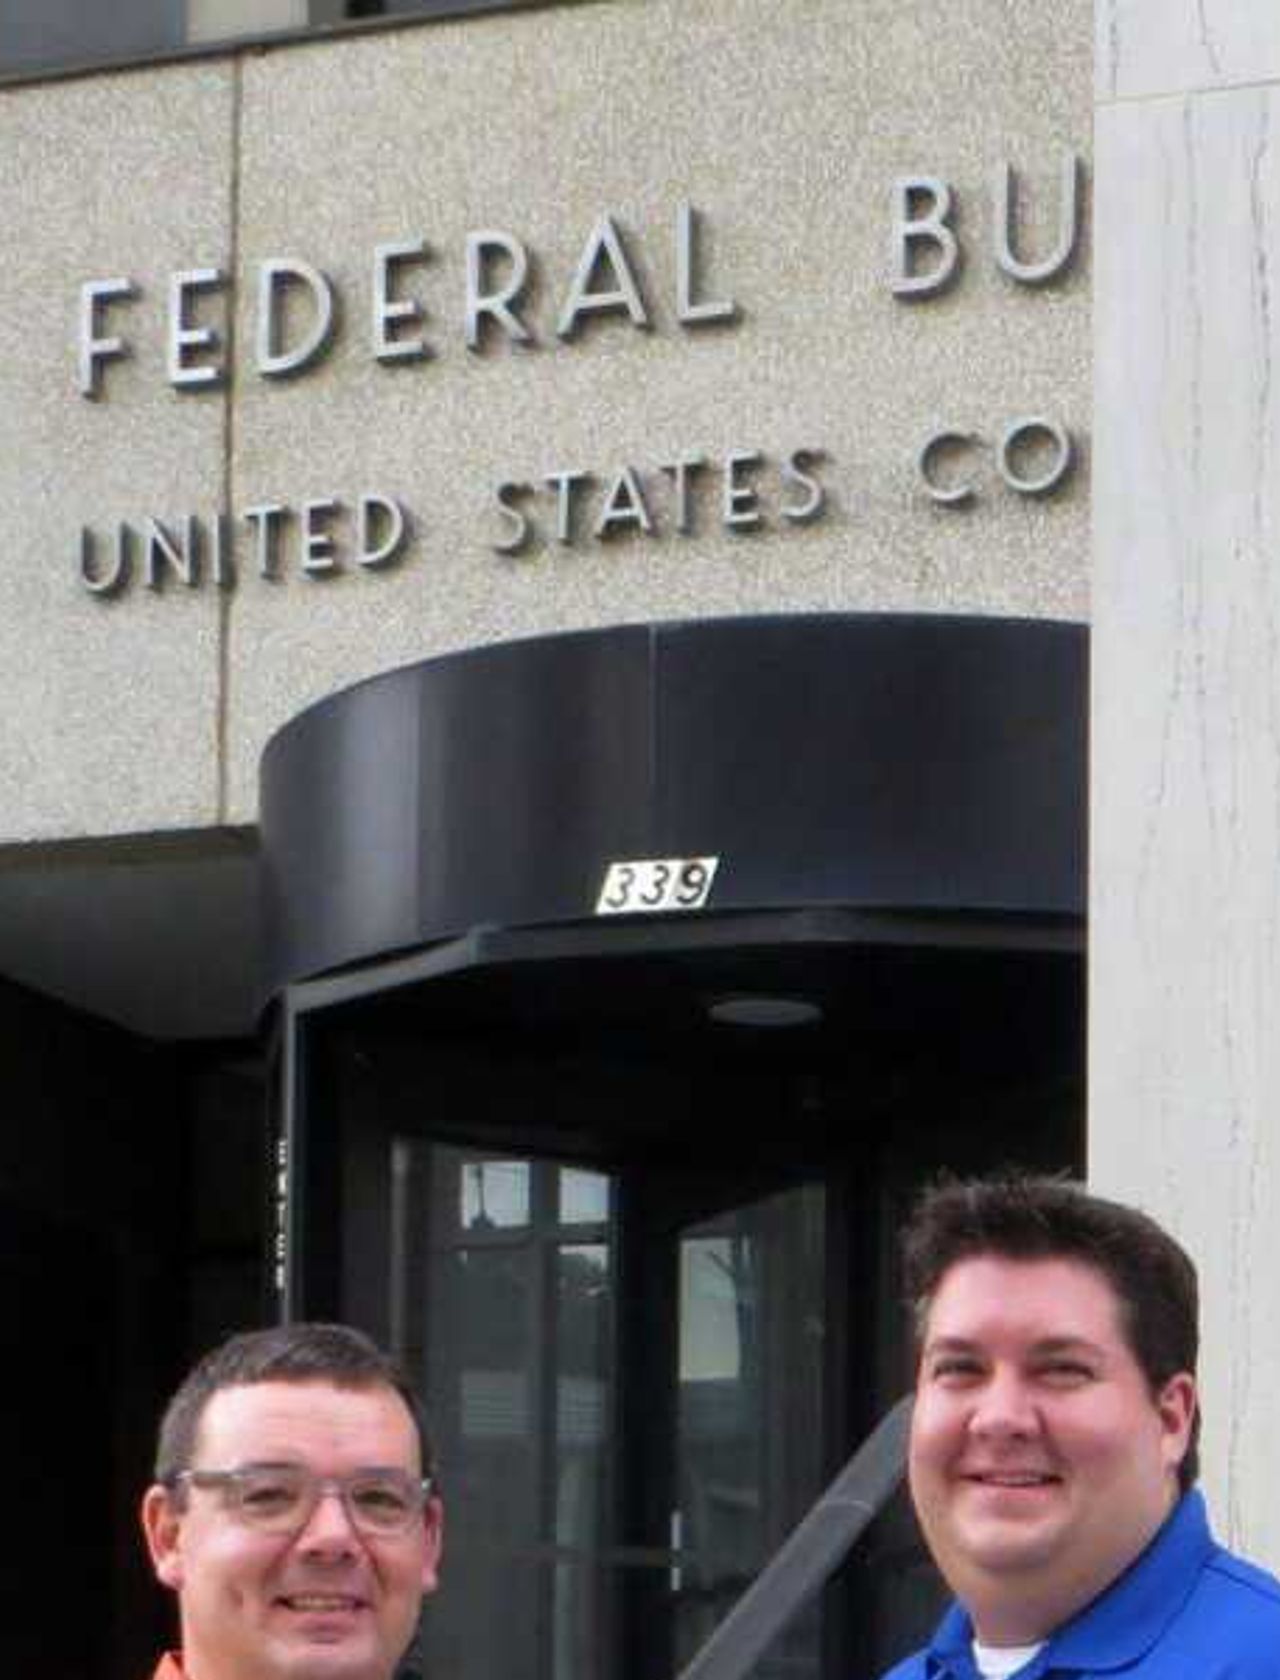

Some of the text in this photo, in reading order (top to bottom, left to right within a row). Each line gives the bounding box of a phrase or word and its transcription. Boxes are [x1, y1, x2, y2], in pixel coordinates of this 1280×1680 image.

[80, 199, 740, 398] FEDERAL
[77, 493, 406, 594] UNITED
[492, 447, 826, 553] STATES
[604, 862, 708, 909] 339
